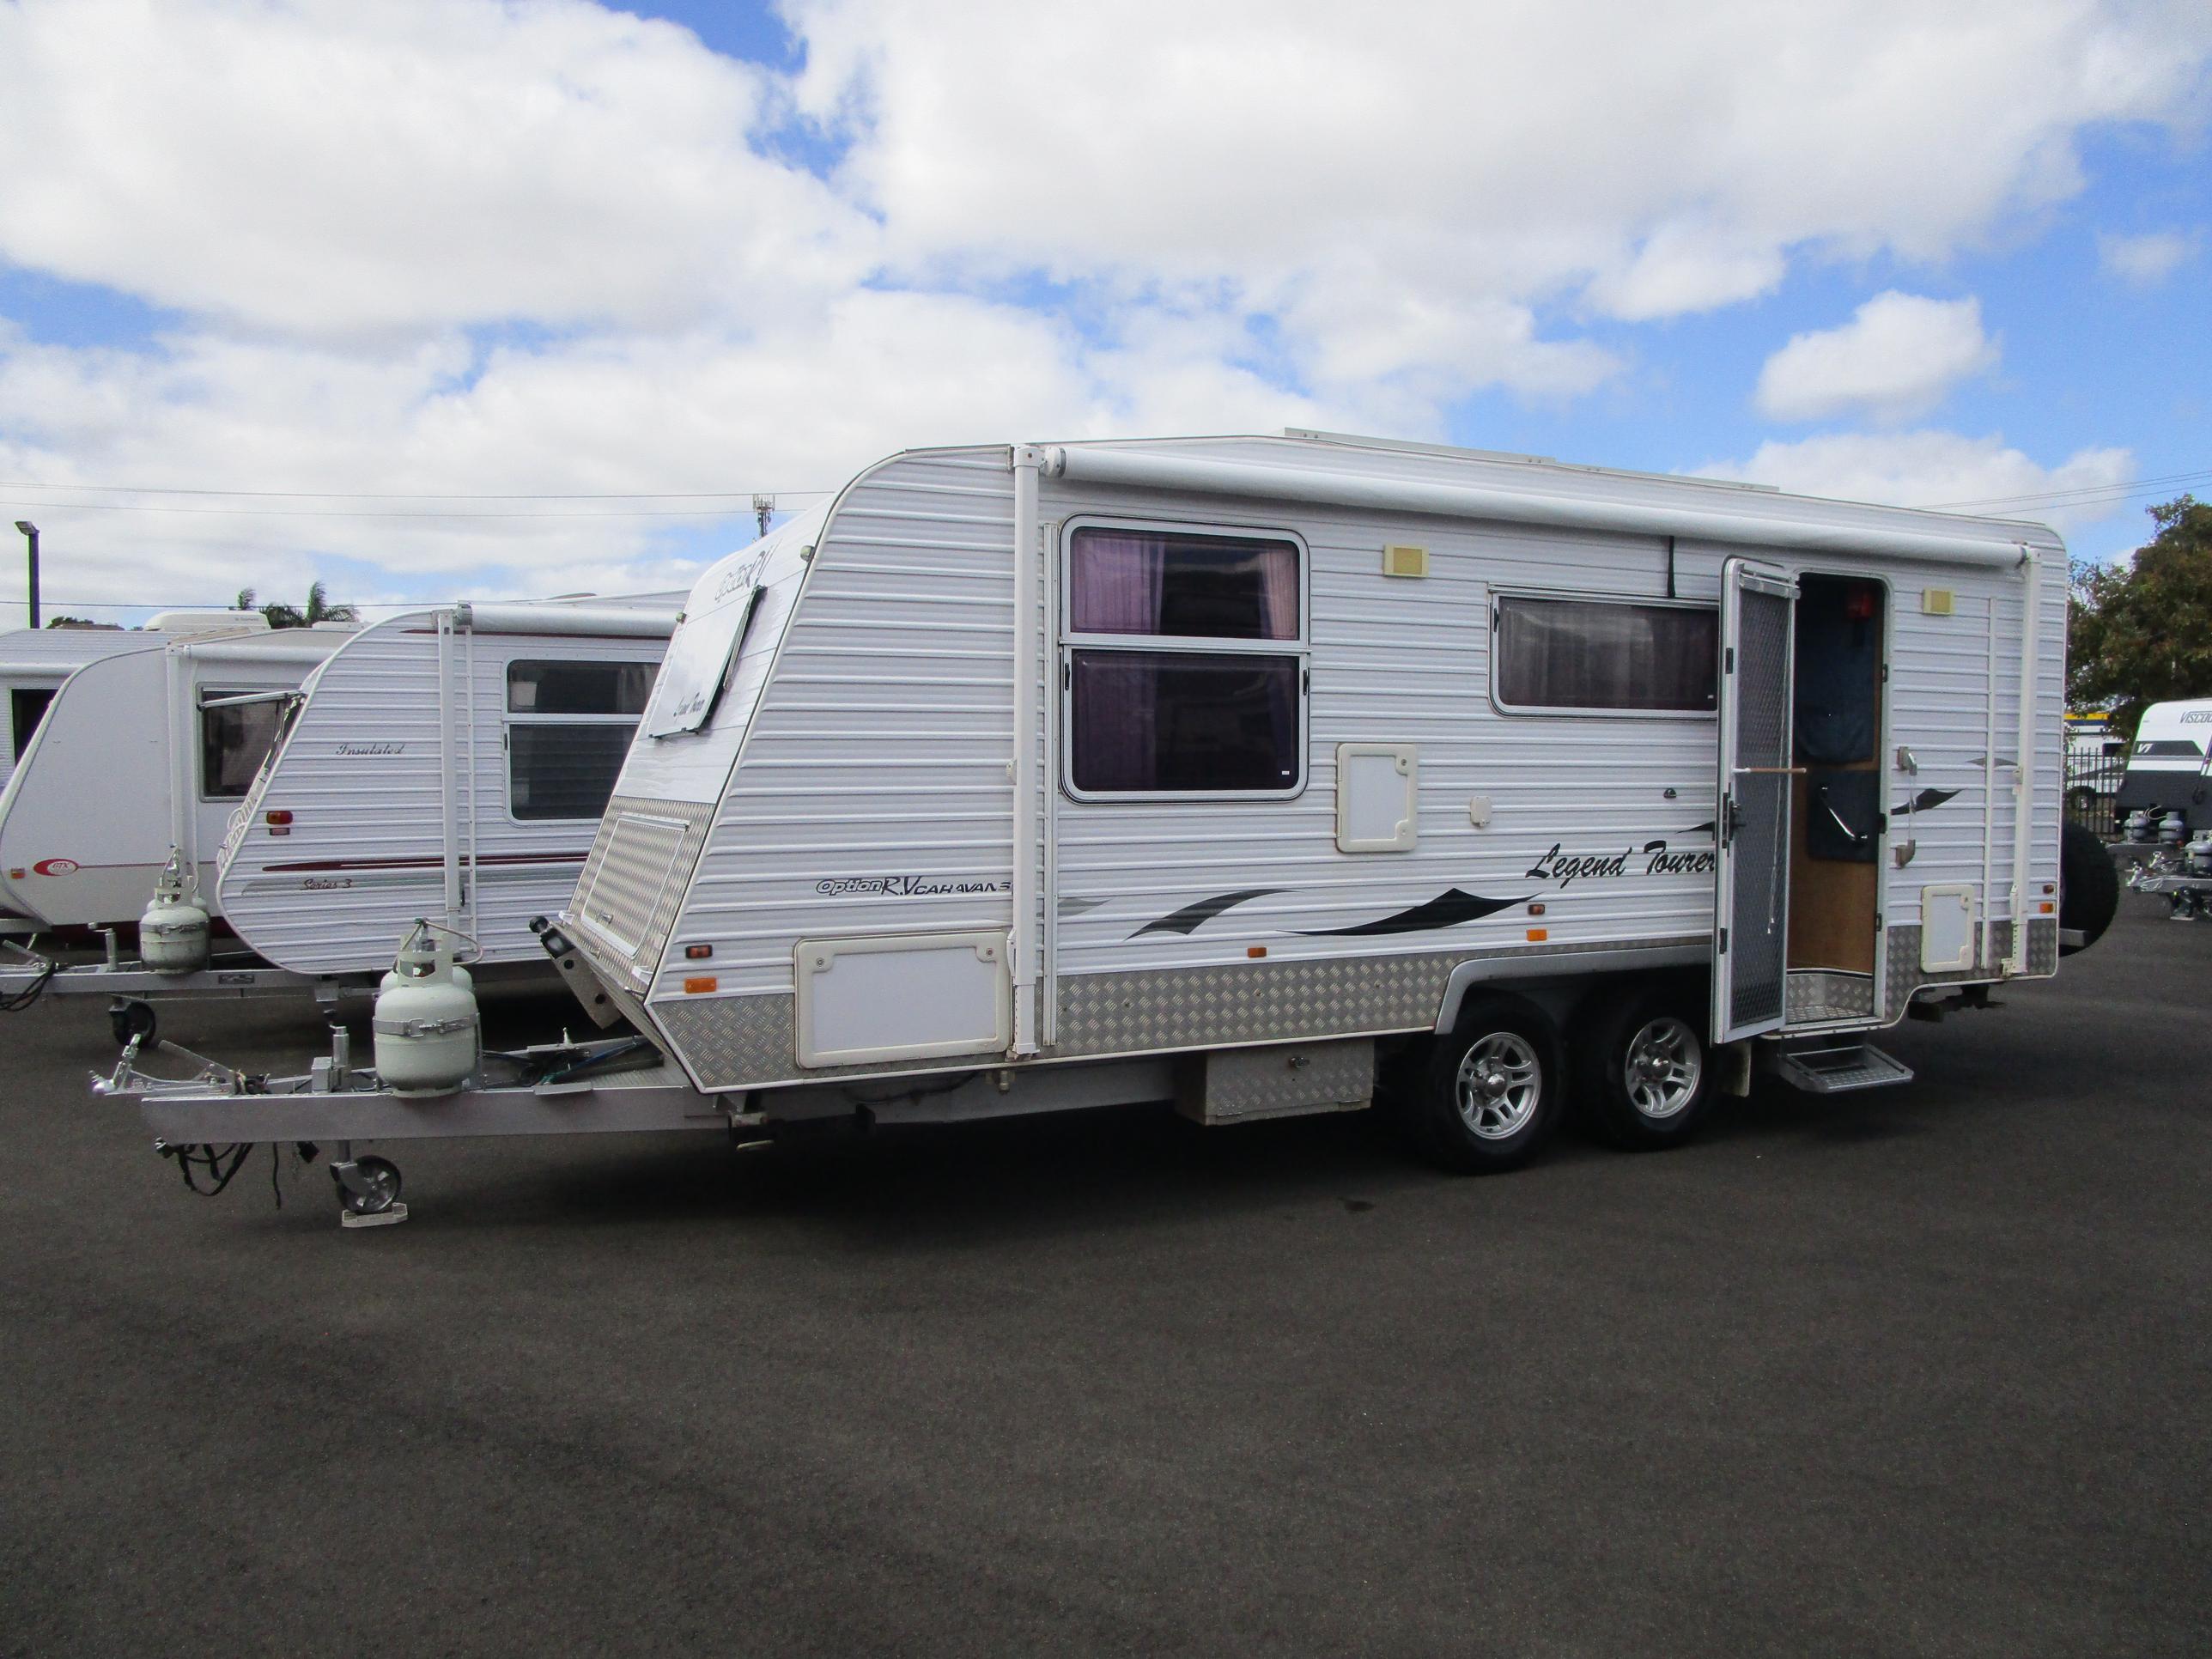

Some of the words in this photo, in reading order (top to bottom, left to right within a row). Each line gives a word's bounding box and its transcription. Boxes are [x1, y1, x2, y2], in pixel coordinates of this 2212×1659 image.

[336, 742, 405, 755] Insulated
[1525, 842, 1632, 889] Legend
[1644, 840, 1715, 875] Tourer
[300, 878, 337, 890] Series
[343, 878, 353, 889] 3
[817, 878, 883, 896] Option
